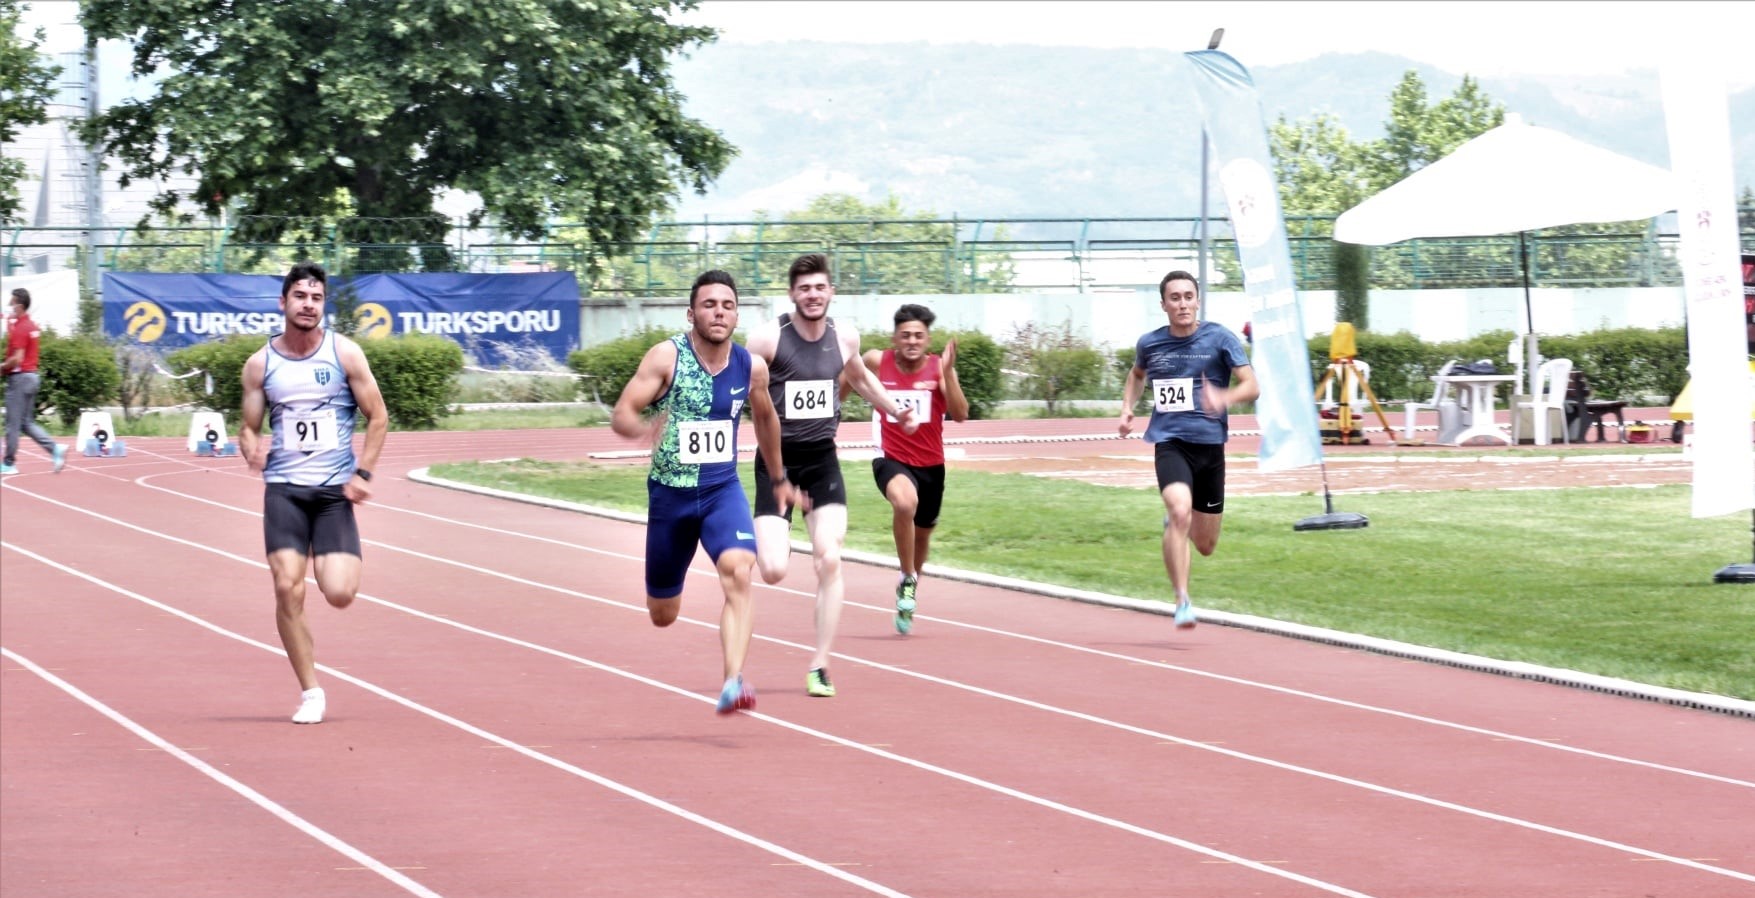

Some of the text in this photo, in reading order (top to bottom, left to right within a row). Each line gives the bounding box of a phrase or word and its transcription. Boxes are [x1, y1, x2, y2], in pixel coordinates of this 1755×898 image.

[399, 309, 560, 335] TURKSPORU
[793, 389, 827, 410] 684
[1159, 386, 1186, 405] 524
[296, 421, 318, 442] 91
[688, 430, 726, 454] 810
